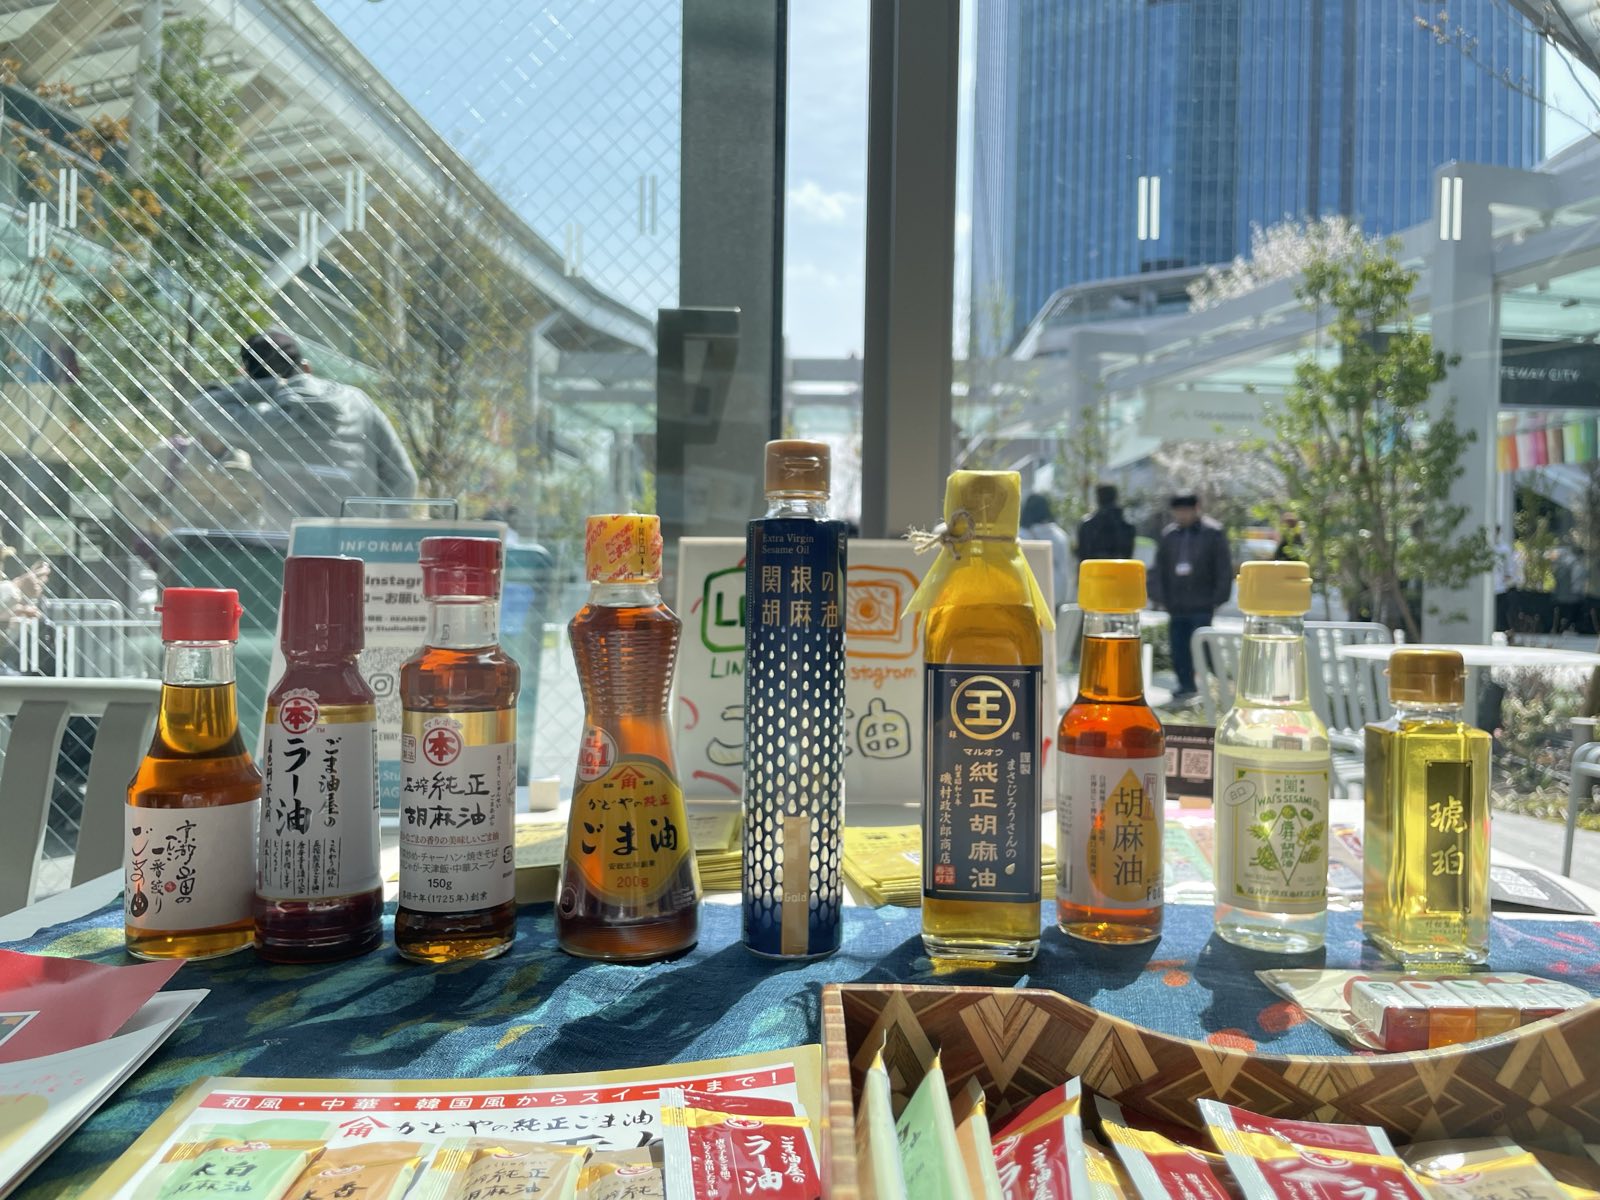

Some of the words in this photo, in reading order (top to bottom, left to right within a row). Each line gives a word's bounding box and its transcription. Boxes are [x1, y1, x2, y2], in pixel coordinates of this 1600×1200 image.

[340, 540, 420, 552] INFORMA
[762, 545, 794, 554] Sesame
[796, 545, 810, 554] Oil
[763, 533, 784, 543] Extra
[787, 533, 814, 545] Virgin
[762, 565, 834, 595] 関根の
[762, 599, 838, 628] 胡麻油
[964, 690, 1002, 726] 王
[963, 748, 1004, 757] マルオウ
[276, 738, 312, 837] ラー油
[319, 737, 342, 828] ごま油屋の
[404, 803, 486, 829] 胡麻油
[939, 771, 953, 864] 磯村政次郎商店
[968, 761, 999, 888] 純正胡麻油
[1005, 759, 1018, 859] まさじろうさんの
[582, 816, 678, 855] ごま油
[1112, 787, 1144, 886] 胡麻油
[1429, 795, 1468, 877] 琥珀
[427, 879, 452, 890] 150g
[617, 876, 649, 888] 200g
[784, 892, 807, 902] Gold
[398, 1109, 653, 1135] かどやの純正ごま油
[743, 1135, 783, 1194] ラー油
[780, 1135, 806, 1184] ごま油屋の
